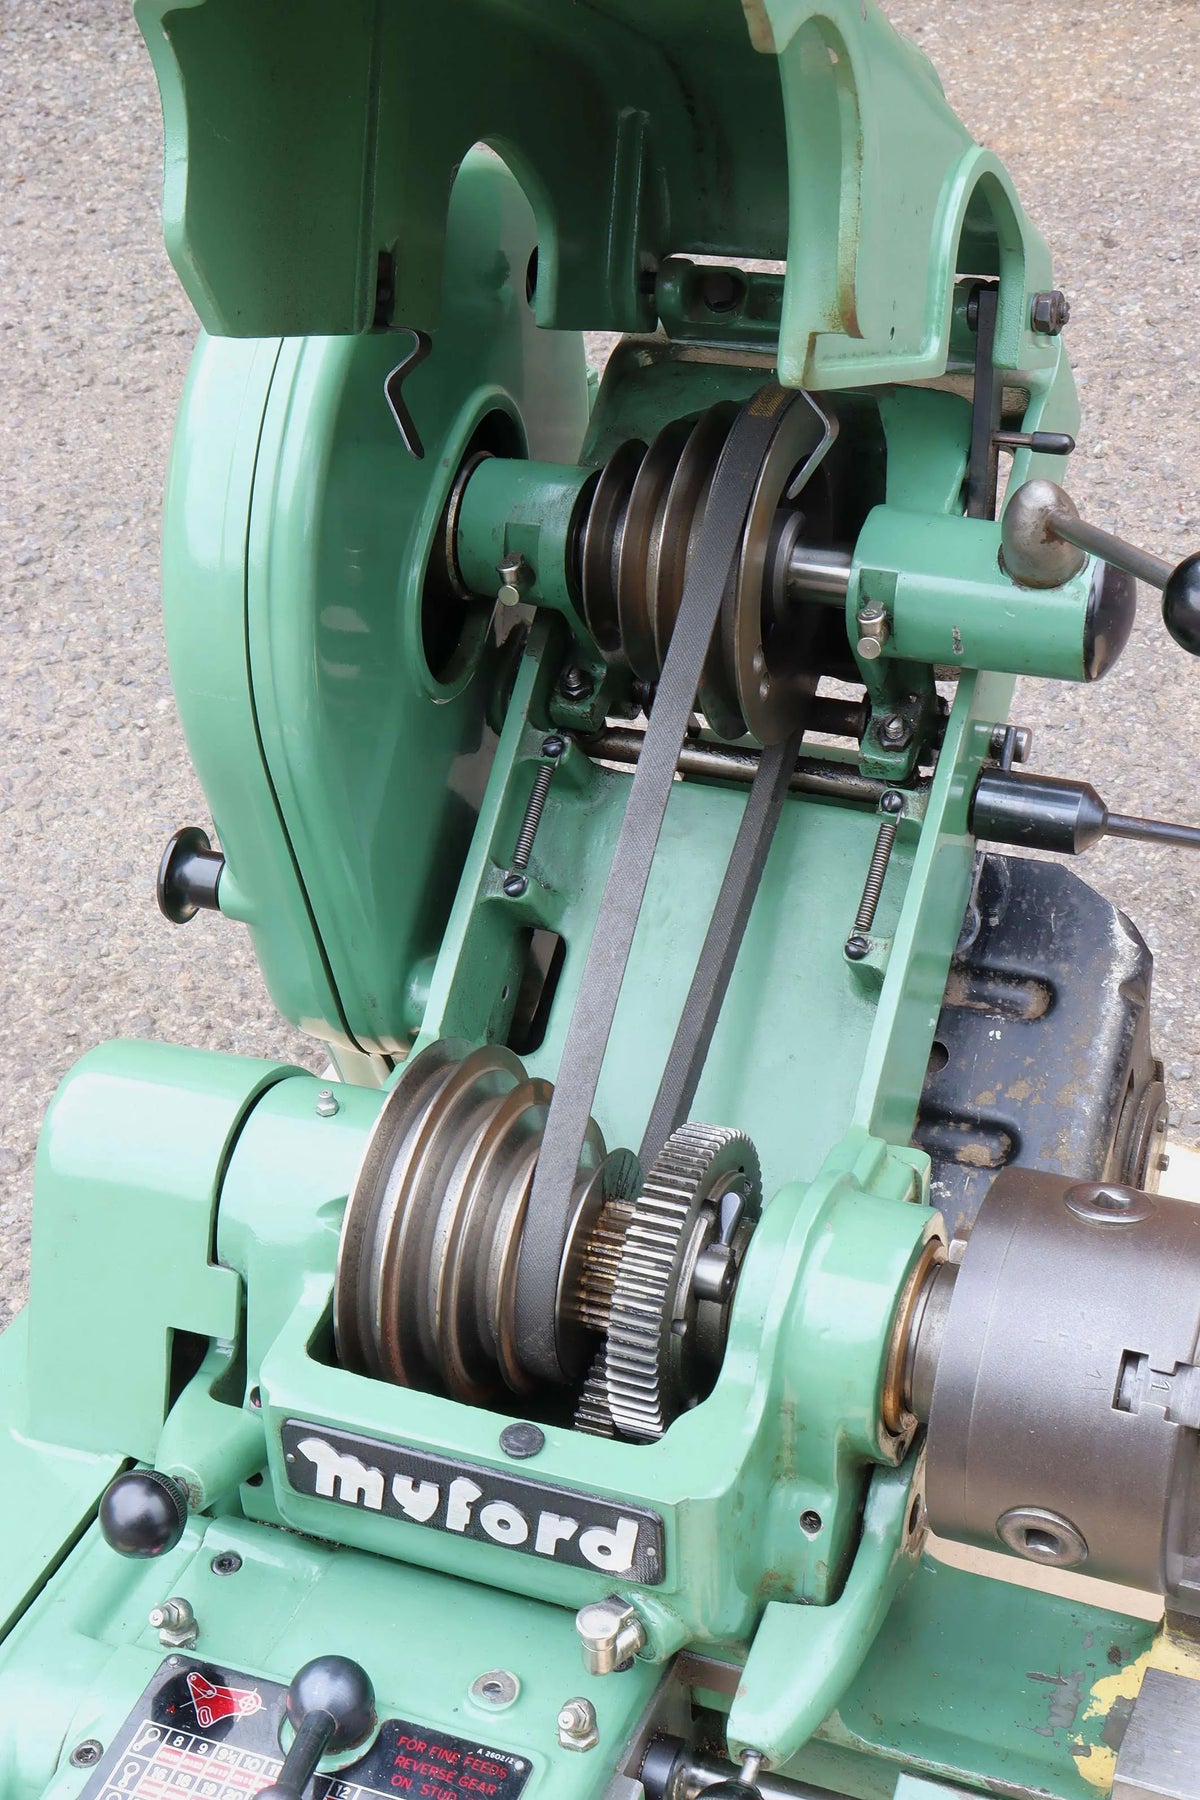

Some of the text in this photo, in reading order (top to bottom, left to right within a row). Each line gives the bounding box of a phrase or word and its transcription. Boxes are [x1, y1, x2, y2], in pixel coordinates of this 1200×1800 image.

[173, 1735, 185, 1747] 8
[197, 1743, 209, 1754] 9
[243, 1755, 260, 1769] 10
[335, 1784, 351, 1800] 12
[394, 1755, 497, 1796] REVERSE GEAR
[397, 1736, 508, 1779] FOR FINE FEEDS
[390, 1775, 413, 1790] ON
